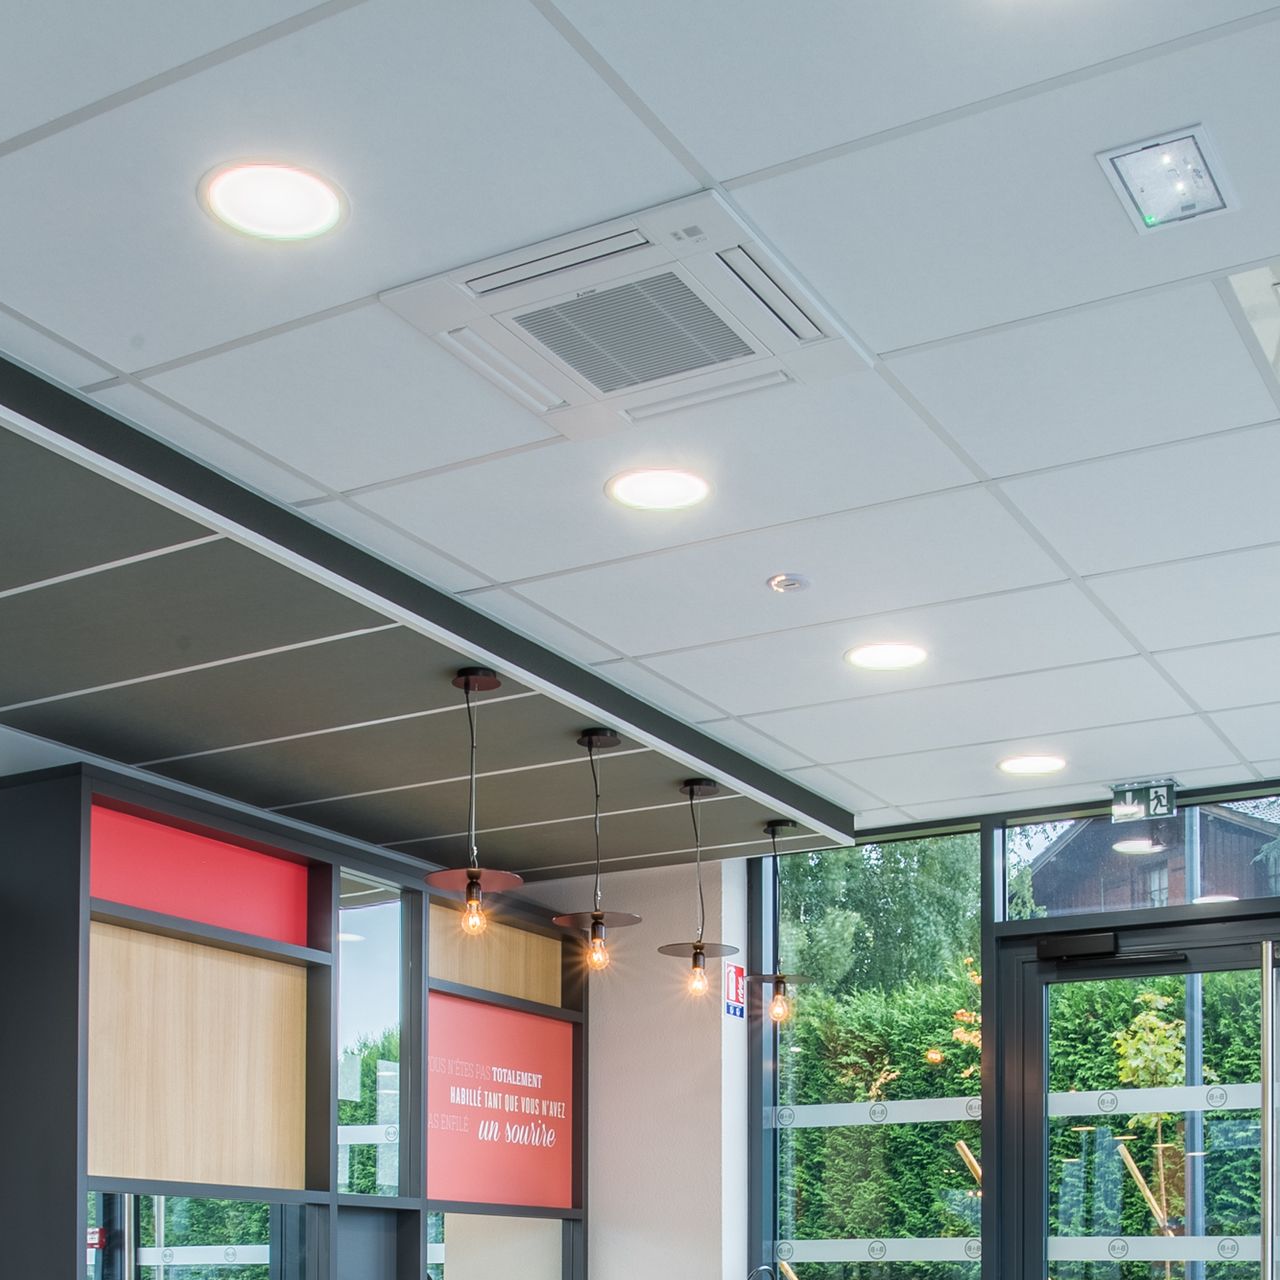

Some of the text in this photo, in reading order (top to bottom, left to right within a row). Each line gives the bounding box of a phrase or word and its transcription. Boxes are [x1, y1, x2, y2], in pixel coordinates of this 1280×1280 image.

[491, 1066, 543, 1089] TOTALEMENT
[450, 1085, 566, 1119] HABILLÉ TANT QUE VOUS N'AVEZ
[478, 1119, 557, 1148] un sourire
